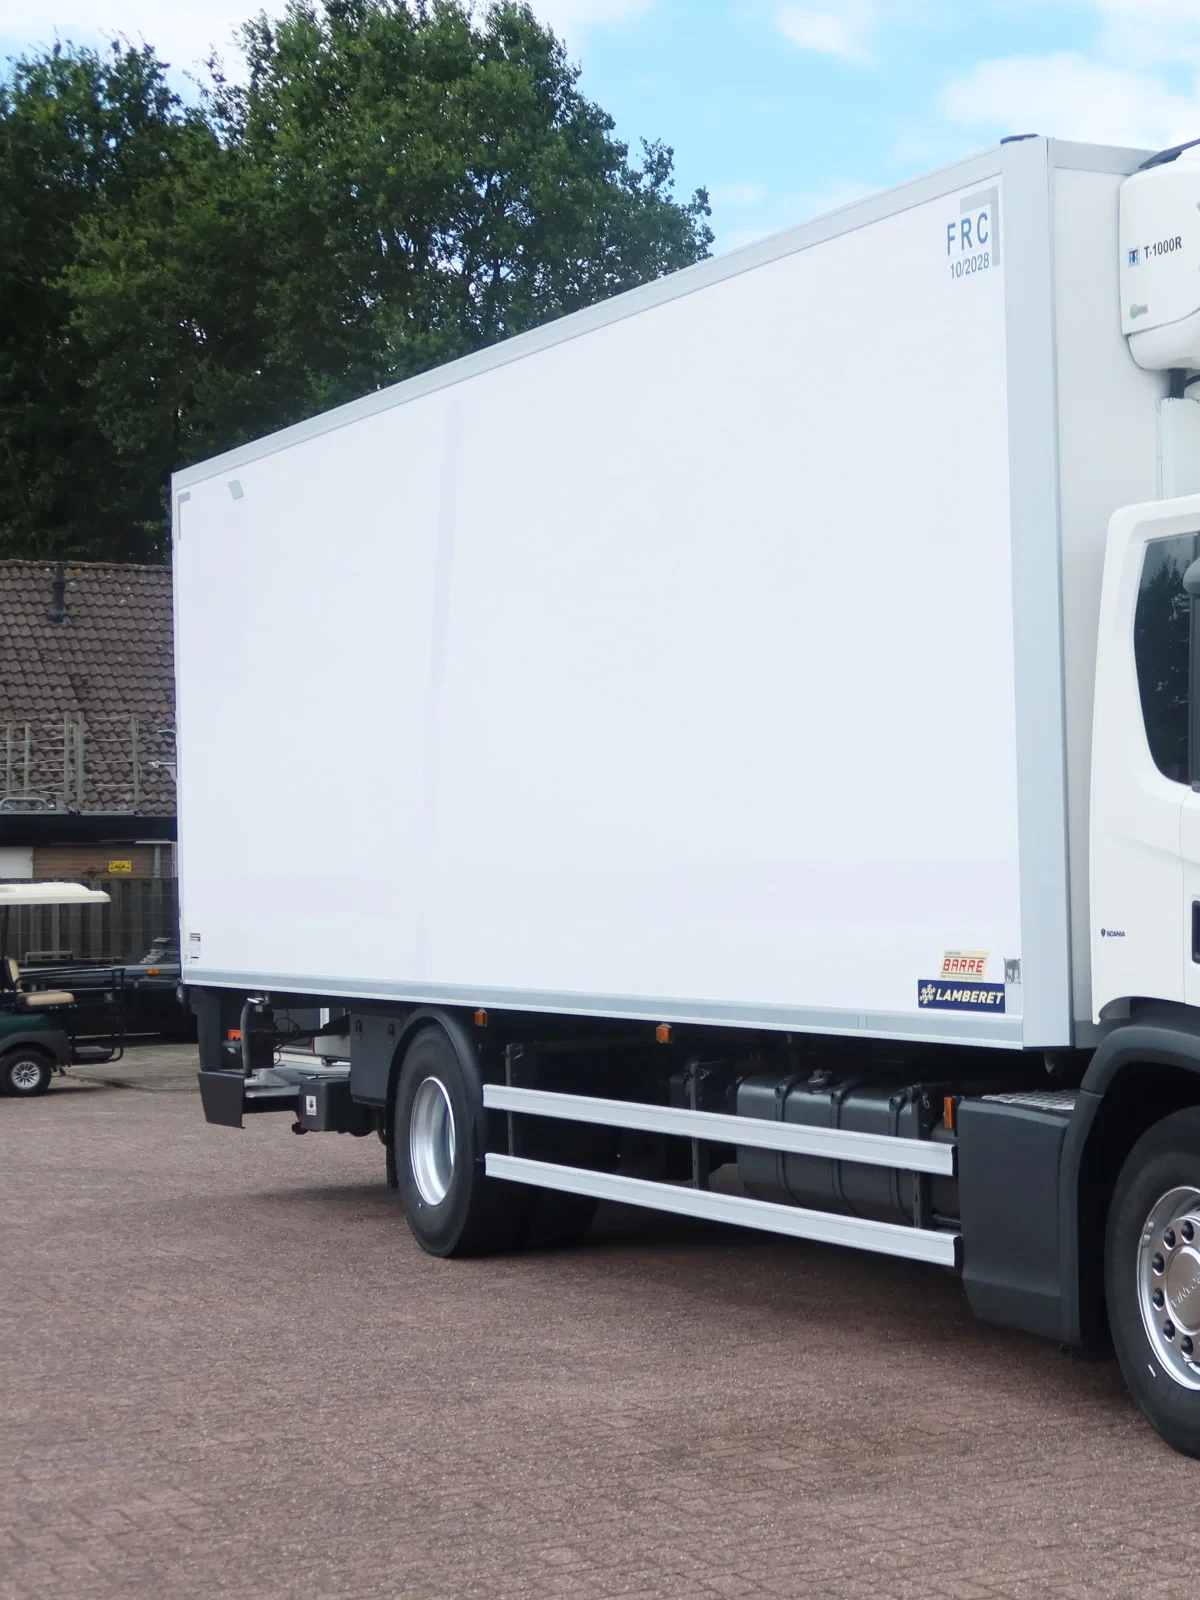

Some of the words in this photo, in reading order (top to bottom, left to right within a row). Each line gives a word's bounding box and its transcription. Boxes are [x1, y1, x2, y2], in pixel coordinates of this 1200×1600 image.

[946, 211, 989, 255] FRC
[1143, 236, 1182, 259] T-1000R
[949, 251, 990, 279] 10/2028
[1106, 930, 1126, 938] SCANIA
[935, 987, 1004, 1005] LAMBERET
